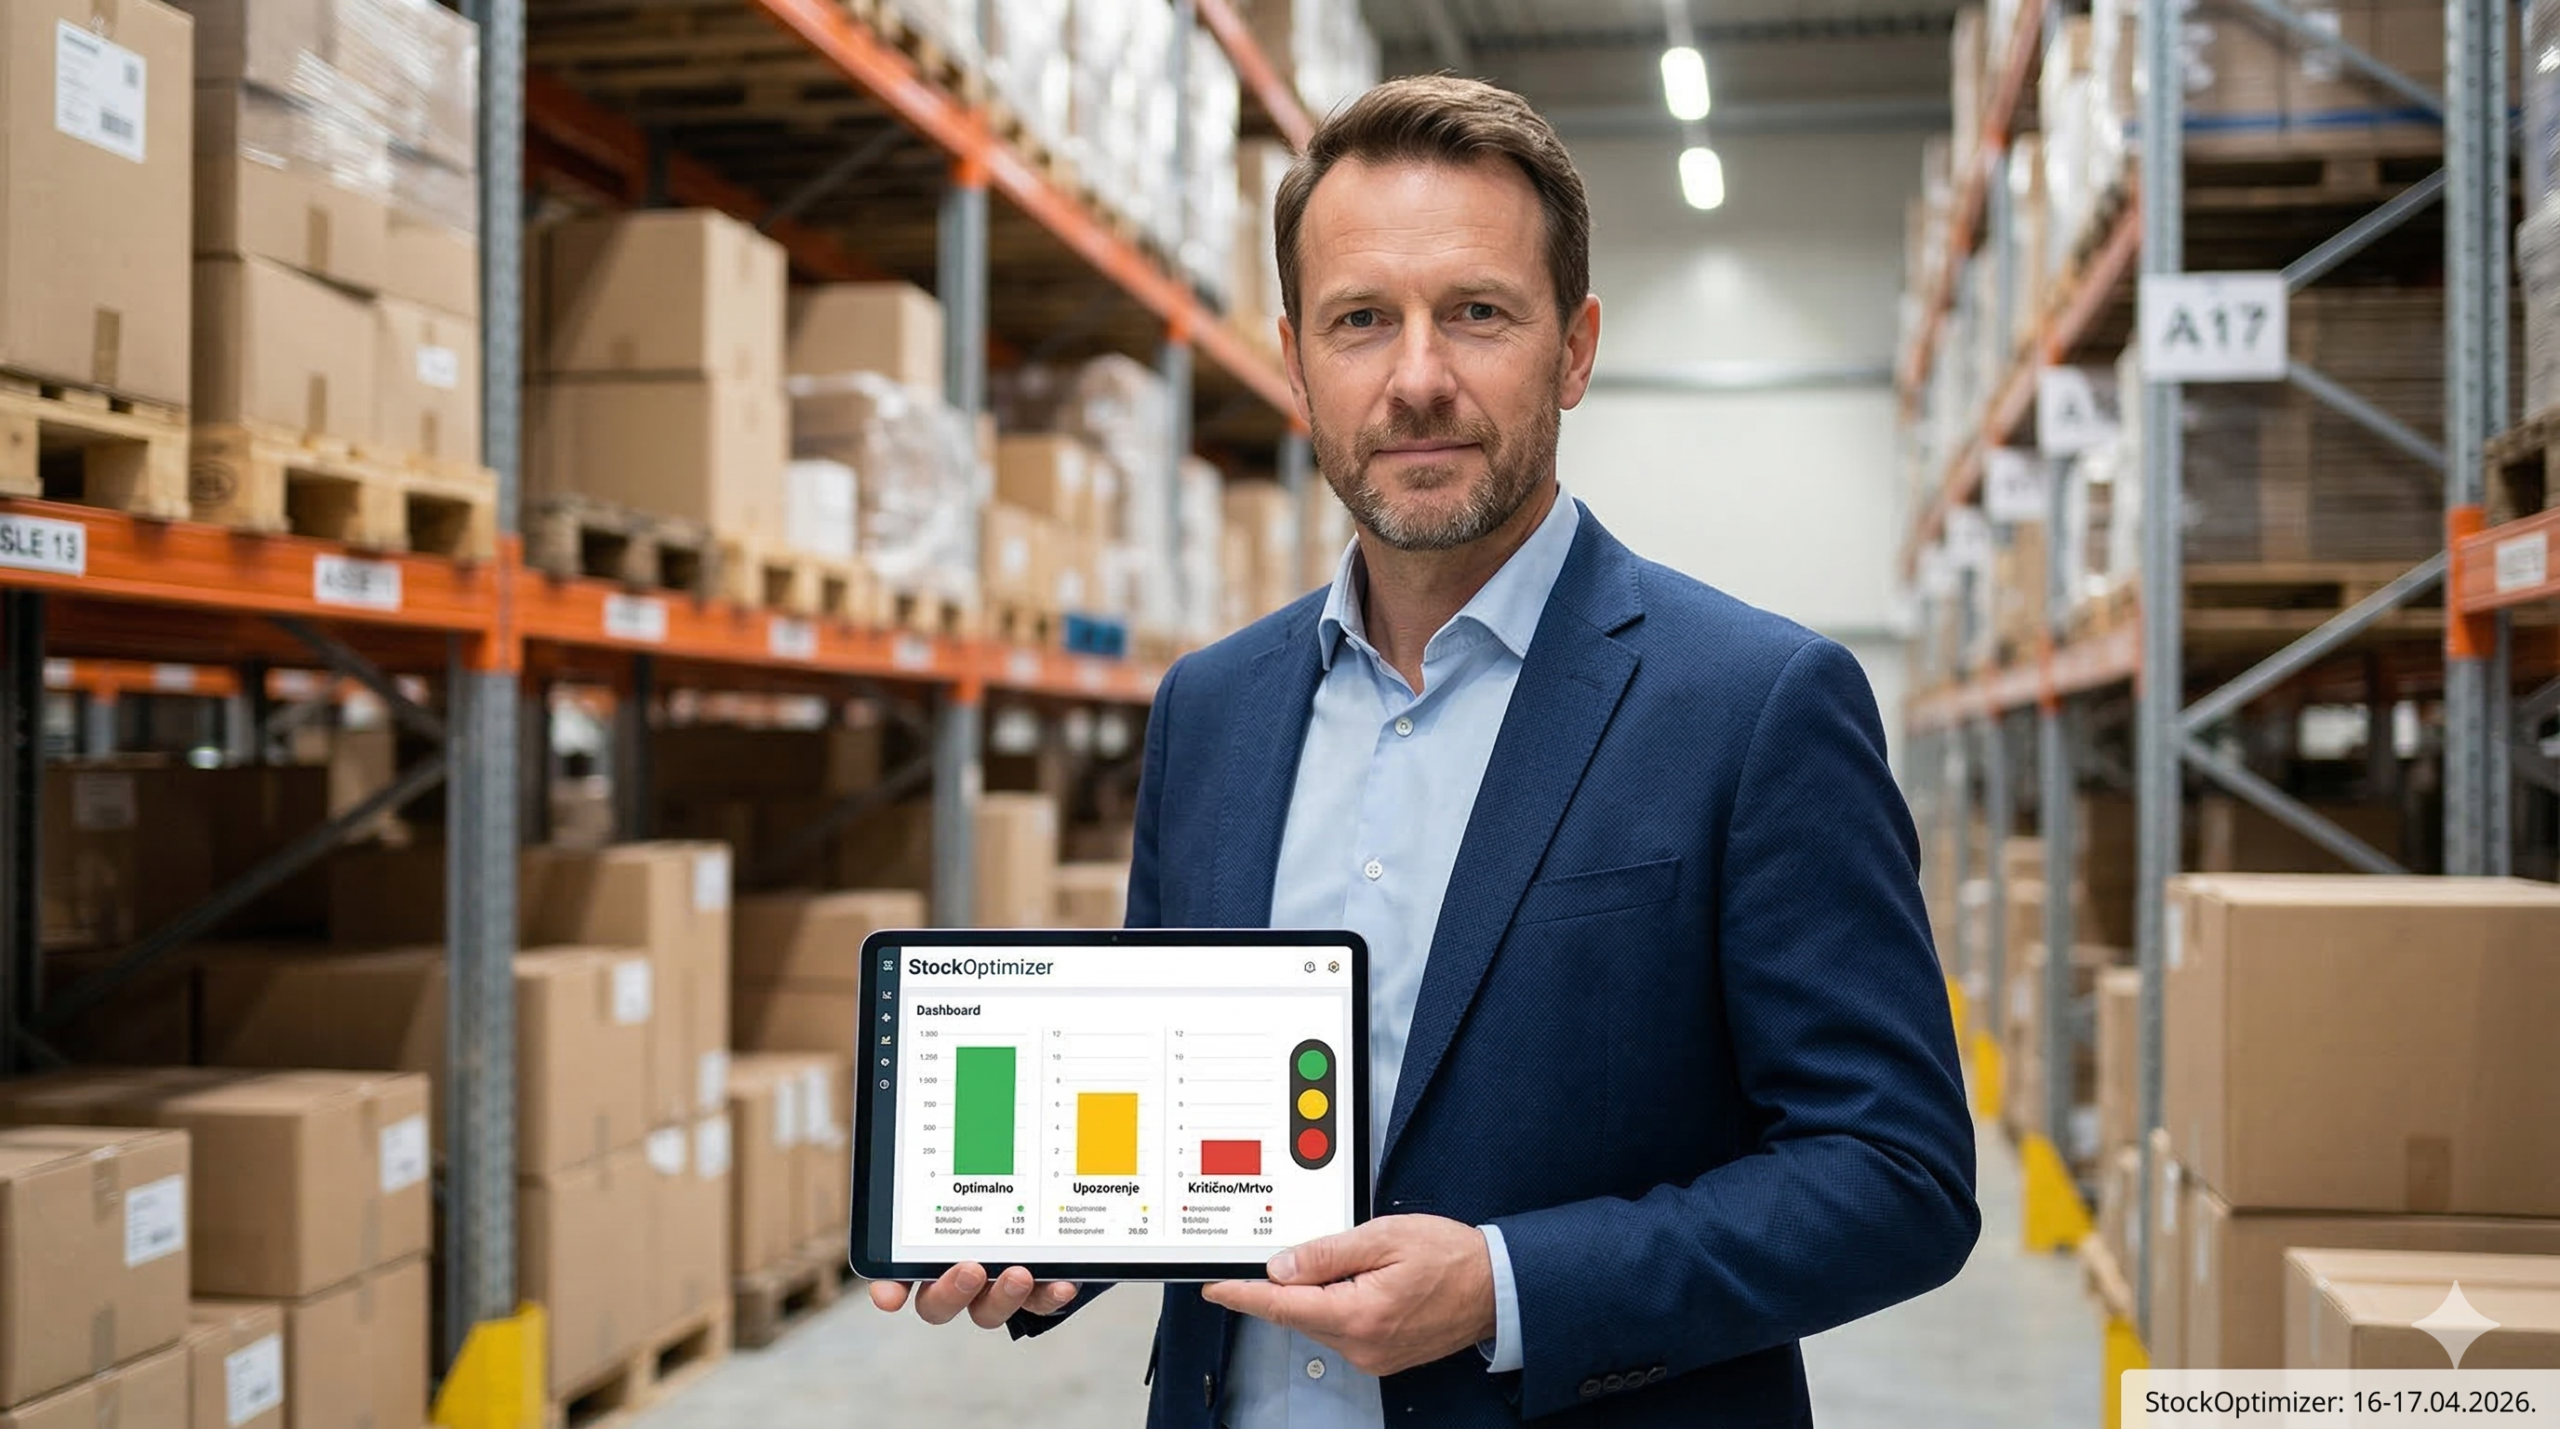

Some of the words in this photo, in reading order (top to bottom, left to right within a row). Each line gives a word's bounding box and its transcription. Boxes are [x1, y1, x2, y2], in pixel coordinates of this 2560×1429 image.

[2163, 302, 2268, 351] A17
[908, 957, 1055, 980] StockOptimizer
[916, 1003, 982, 1016] Dashboard
[952, 1181, 1014, 1197] Optimalno
[1072, 1181, 1141, 1197] Upozorenje
[1187, 1180, 1274, 1195] Kritično/Mrtvo
